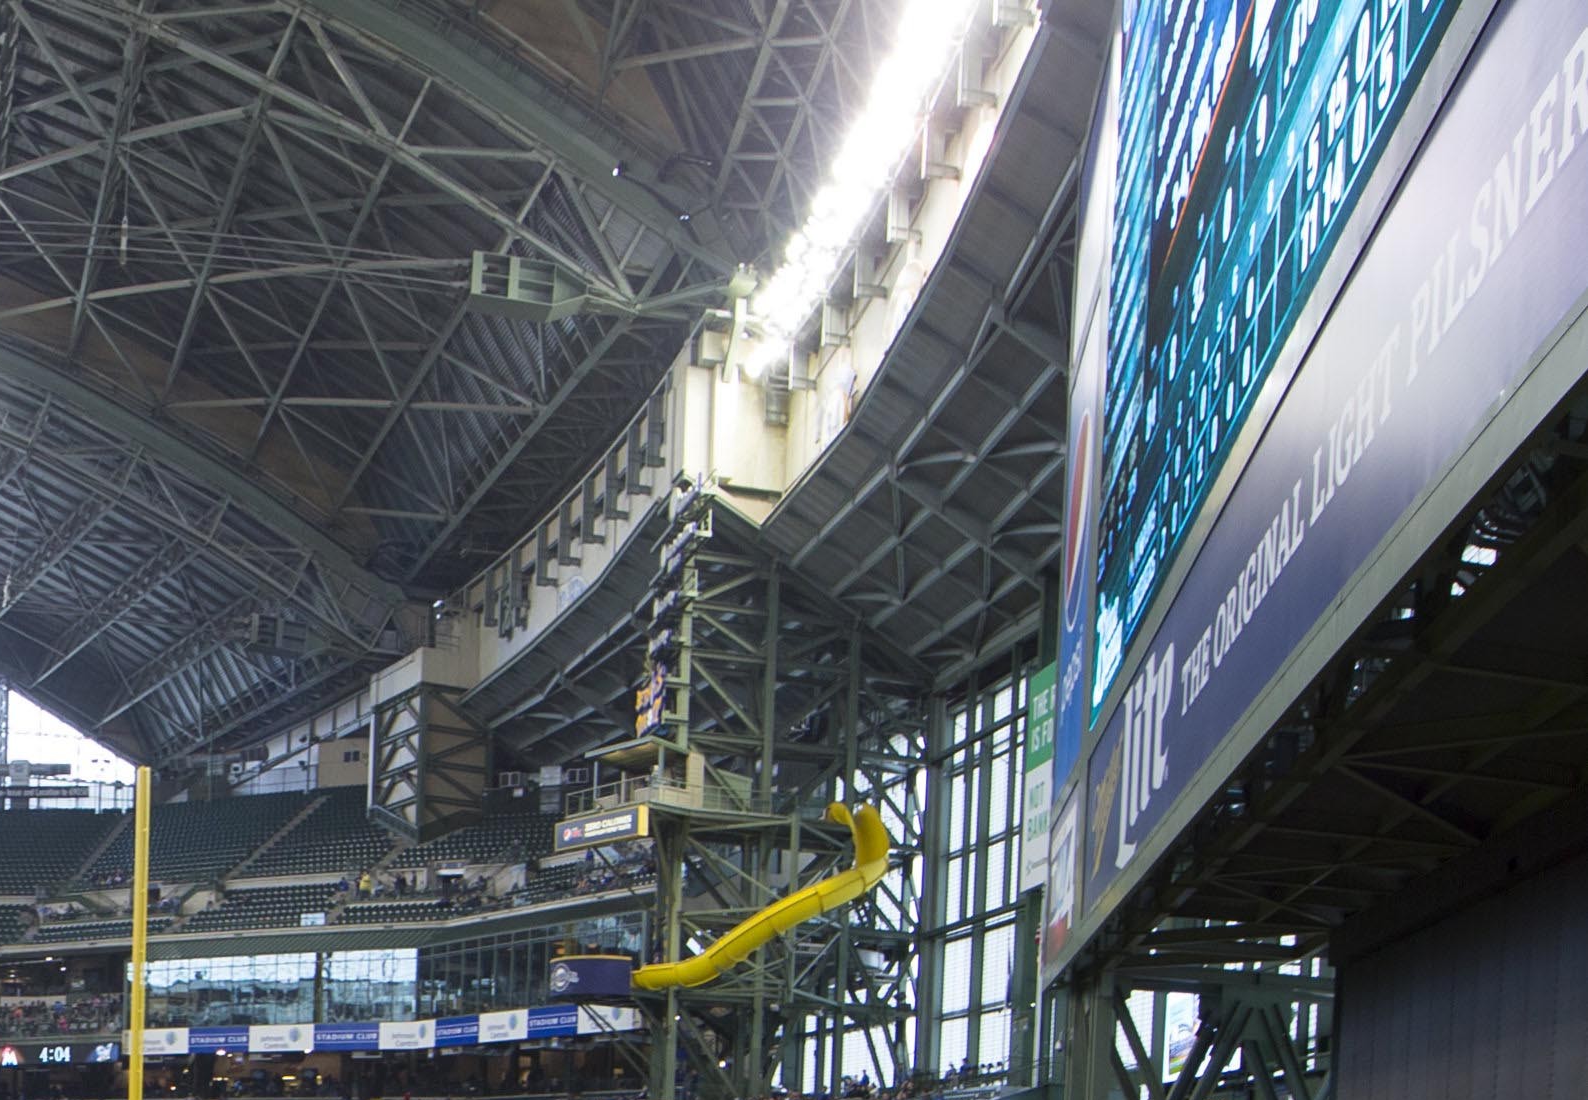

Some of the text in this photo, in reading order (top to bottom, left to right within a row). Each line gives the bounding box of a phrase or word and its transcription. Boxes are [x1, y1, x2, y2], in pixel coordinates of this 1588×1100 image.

[1181, 625, 1212, 716] THE
[1213, 480, 1305, 669] ORIGINAL
[1309, 322, 1400, 528] LIGHT
[39, 1047, 71, 1063] 4:04
